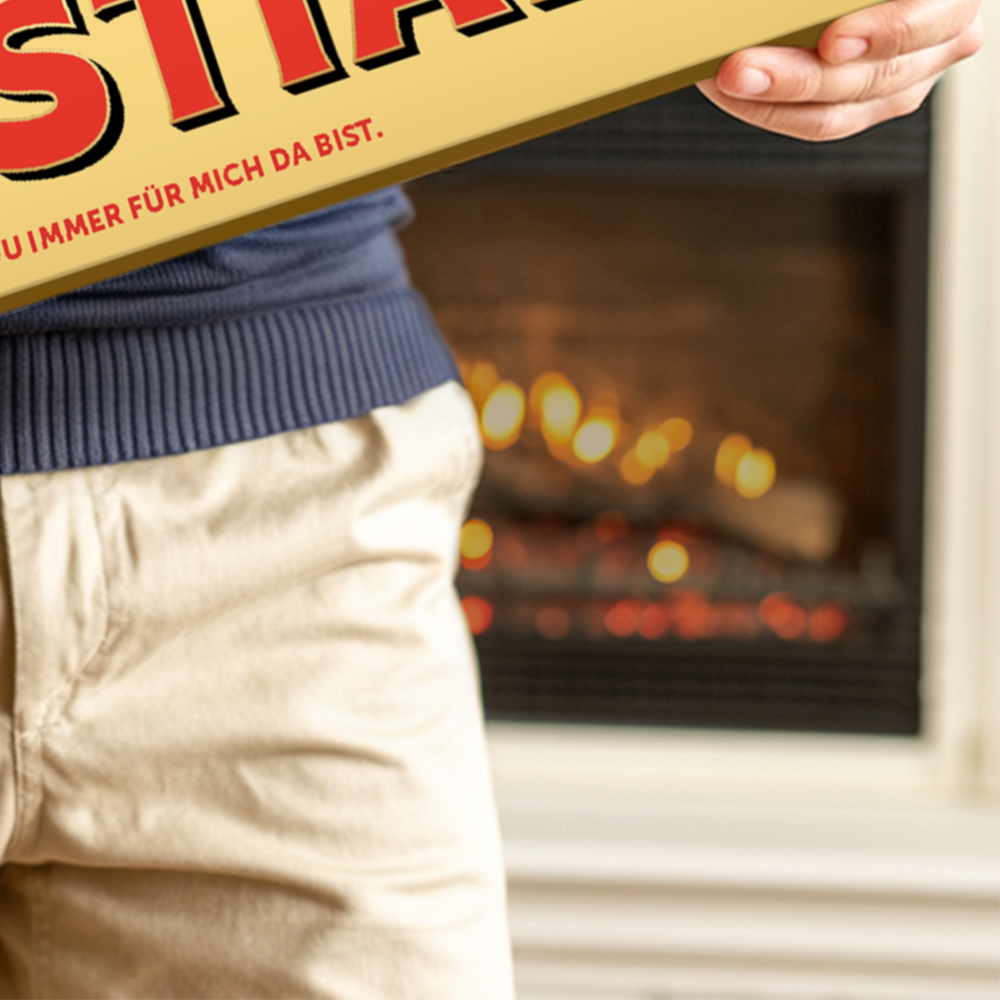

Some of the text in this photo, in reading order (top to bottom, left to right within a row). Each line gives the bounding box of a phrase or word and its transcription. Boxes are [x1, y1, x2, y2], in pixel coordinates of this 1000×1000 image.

[26, 202, 126, 254] IMMER
[127, 182, 186, 221] FÜR
[188, 154, 266, 201] MICH
[269, 131, 314, 173] DA
[313, 117, 385, 159] BIST.
